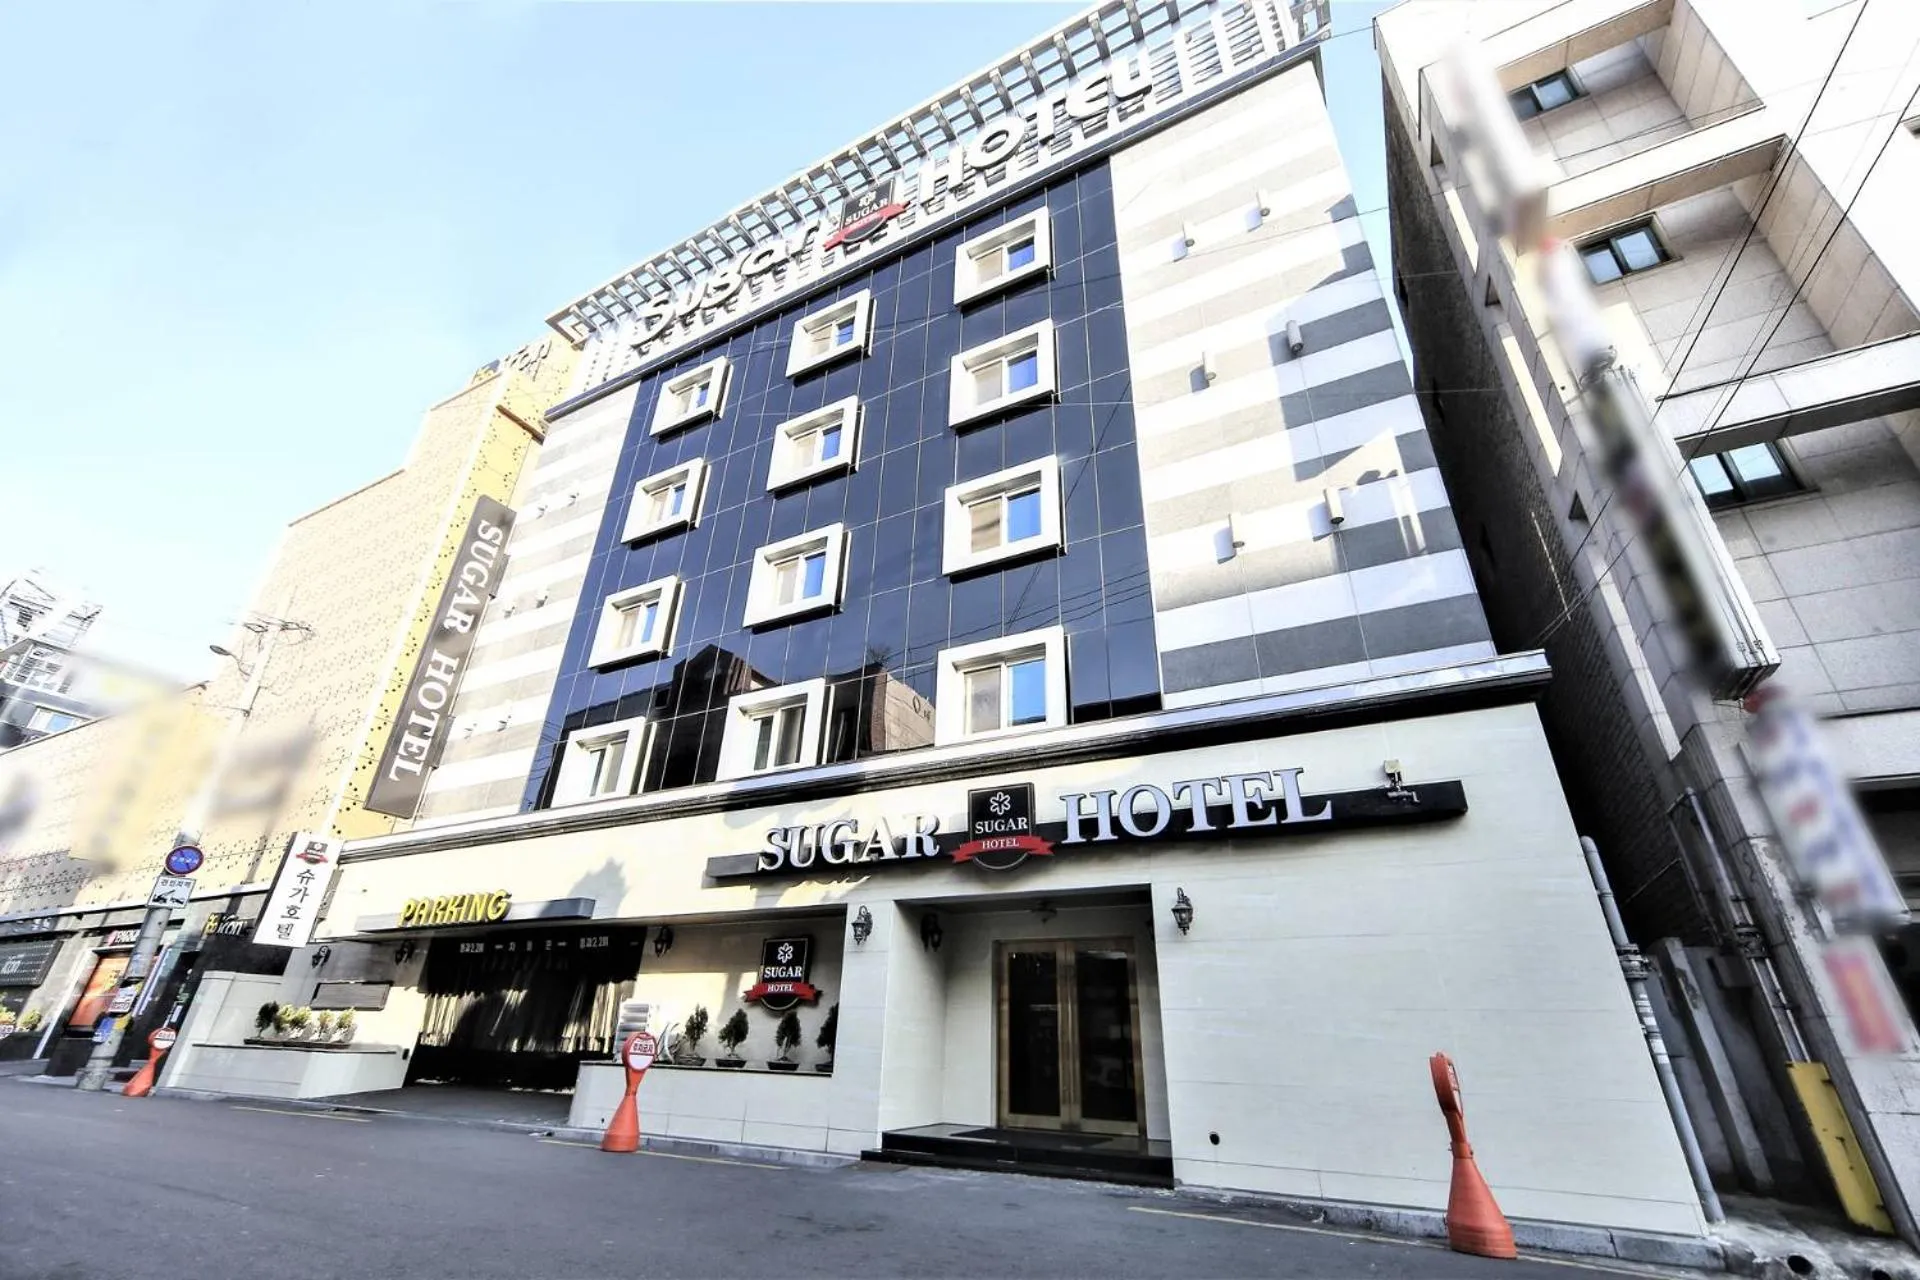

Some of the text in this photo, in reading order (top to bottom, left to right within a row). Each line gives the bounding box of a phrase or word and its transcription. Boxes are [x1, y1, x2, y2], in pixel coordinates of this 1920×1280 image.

[844, 197, 888, 226] SUGAR
[388, 519, 504, 782] SUGAR HOTEL
[757, 767, 1332, 871] SUGAR HOTEL
[975, 816, 1028, 834] SUGAR
[982, 837, 1020, 849] HOTEL
[277, 868, 315, 940] 슈가호텔
[398, 889, 512, 927] PARKING
[764, 966, 803, 978] SUGAR
[767, 983, 795, 993] HOTEL
